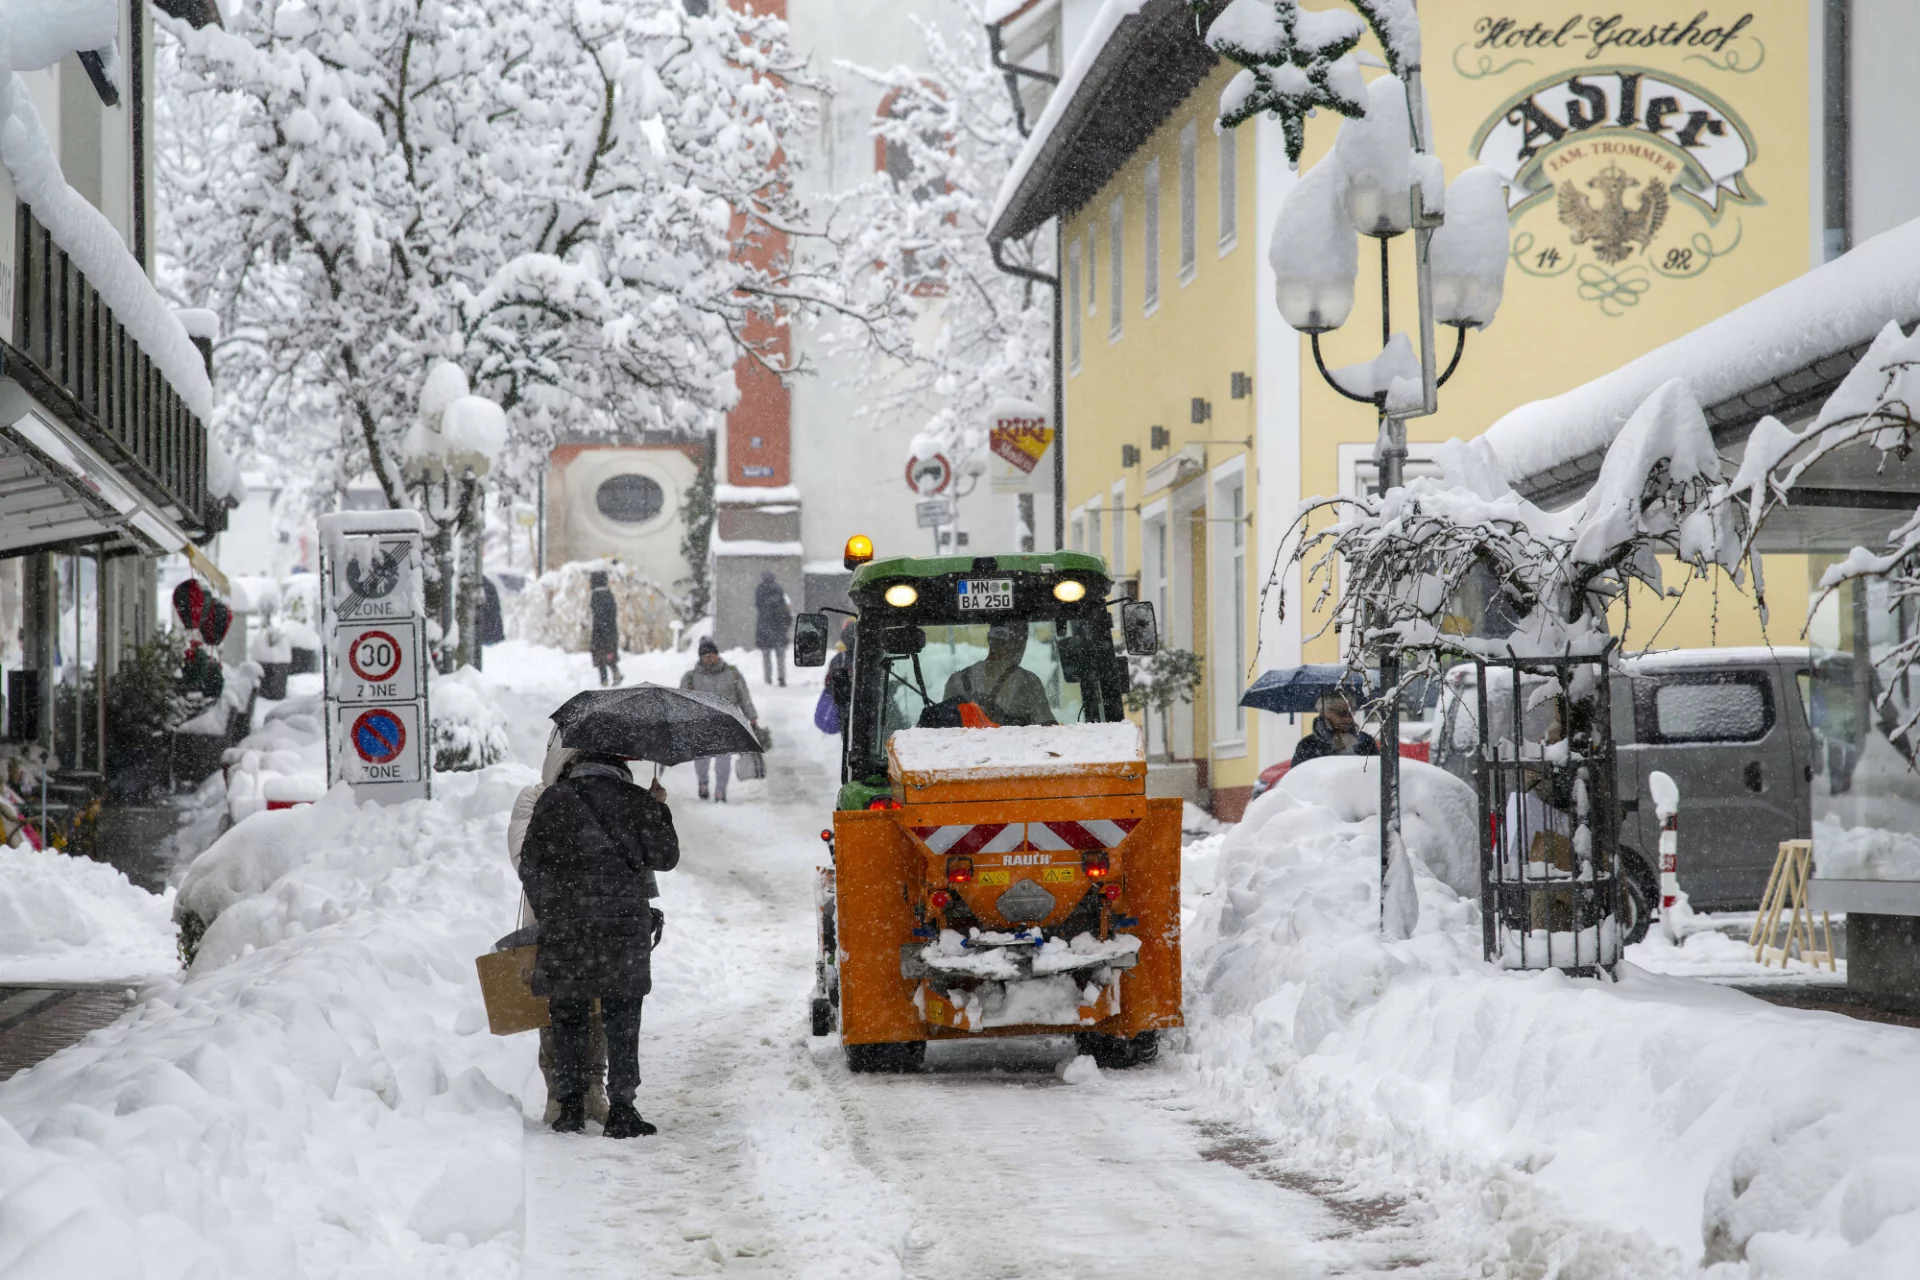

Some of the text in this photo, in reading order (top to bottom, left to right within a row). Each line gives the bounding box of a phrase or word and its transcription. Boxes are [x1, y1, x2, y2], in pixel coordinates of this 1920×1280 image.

[1474, 11, 1753, 59] Hotel-Gasthof
[1507, 71, 1727, 161] Adler
[1549, 141, 1677, 175] FAM. TROMMER
[1535, 247, 1561, 269] 14
[1662, 248, 1693, 270] 92
[971, 581, 989, 594] MN
[354, 602, 394, 616] ZONE
[962, 594, 1010, 609] BA 250
[361, 643, 391, 667] 30
[1002, 853, 1050, 866] RAUCH
